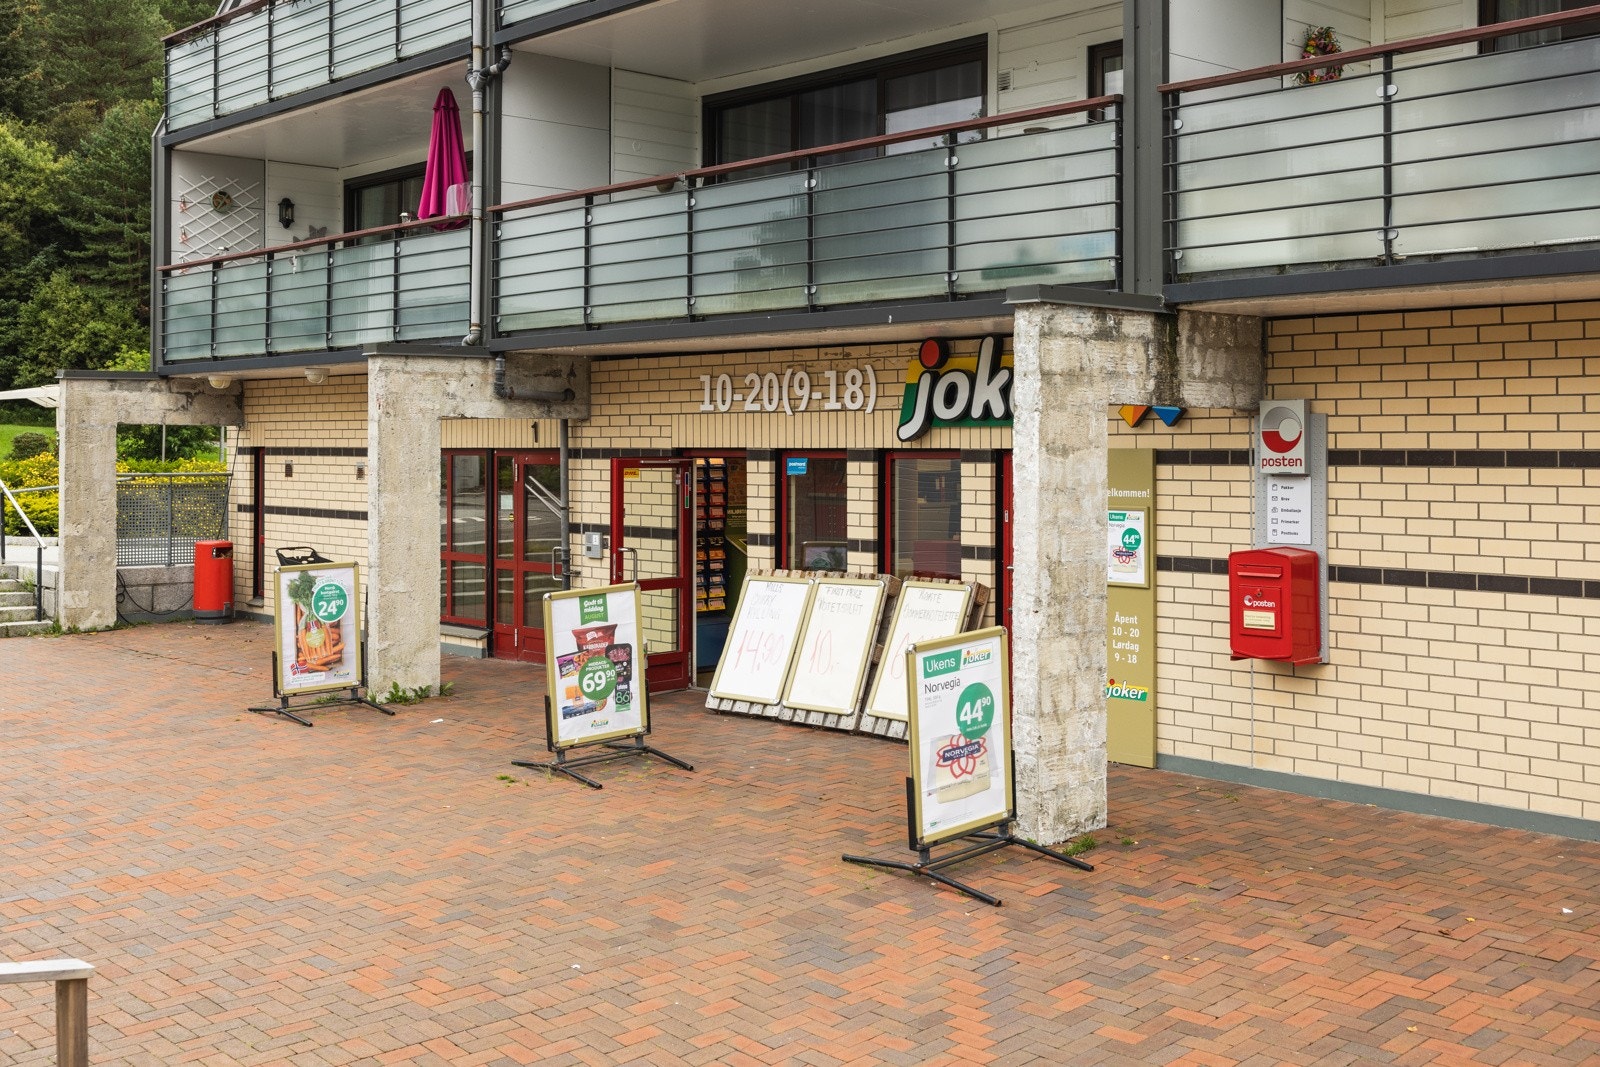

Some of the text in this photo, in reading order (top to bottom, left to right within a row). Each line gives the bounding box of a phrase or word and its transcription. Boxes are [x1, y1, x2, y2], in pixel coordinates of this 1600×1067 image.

[699, 364, 877, 416] 10-20(9-18)
[897, 335, 1014, 442] jok
[531, 421, 538, 443] 1
[1261, 456, 1303, 469] posten
[1107, 488, 1150, 498] elkommen!
[584, 599, 597, 607] Godt
[584, 605, 604, 613] middag
[1253, 600, 1276, 608] posten
[1114, 611, 1138, 624] Åpent
[1112, 626, 1122, 636] 10
[1129, 628, 1140, 637] 20
[1112, 639, 1140, 652] Lørdag
[926, 650, 991, 673] Ukens joker
[1114, 652, 1120, 662] 9
[1127, 654, 1137, 664] 18
[924, 676, 961, 695] Norvegia
[1106, 678, 1145, 700] joker
[944, 744, 979, 758] NORVEGIA
